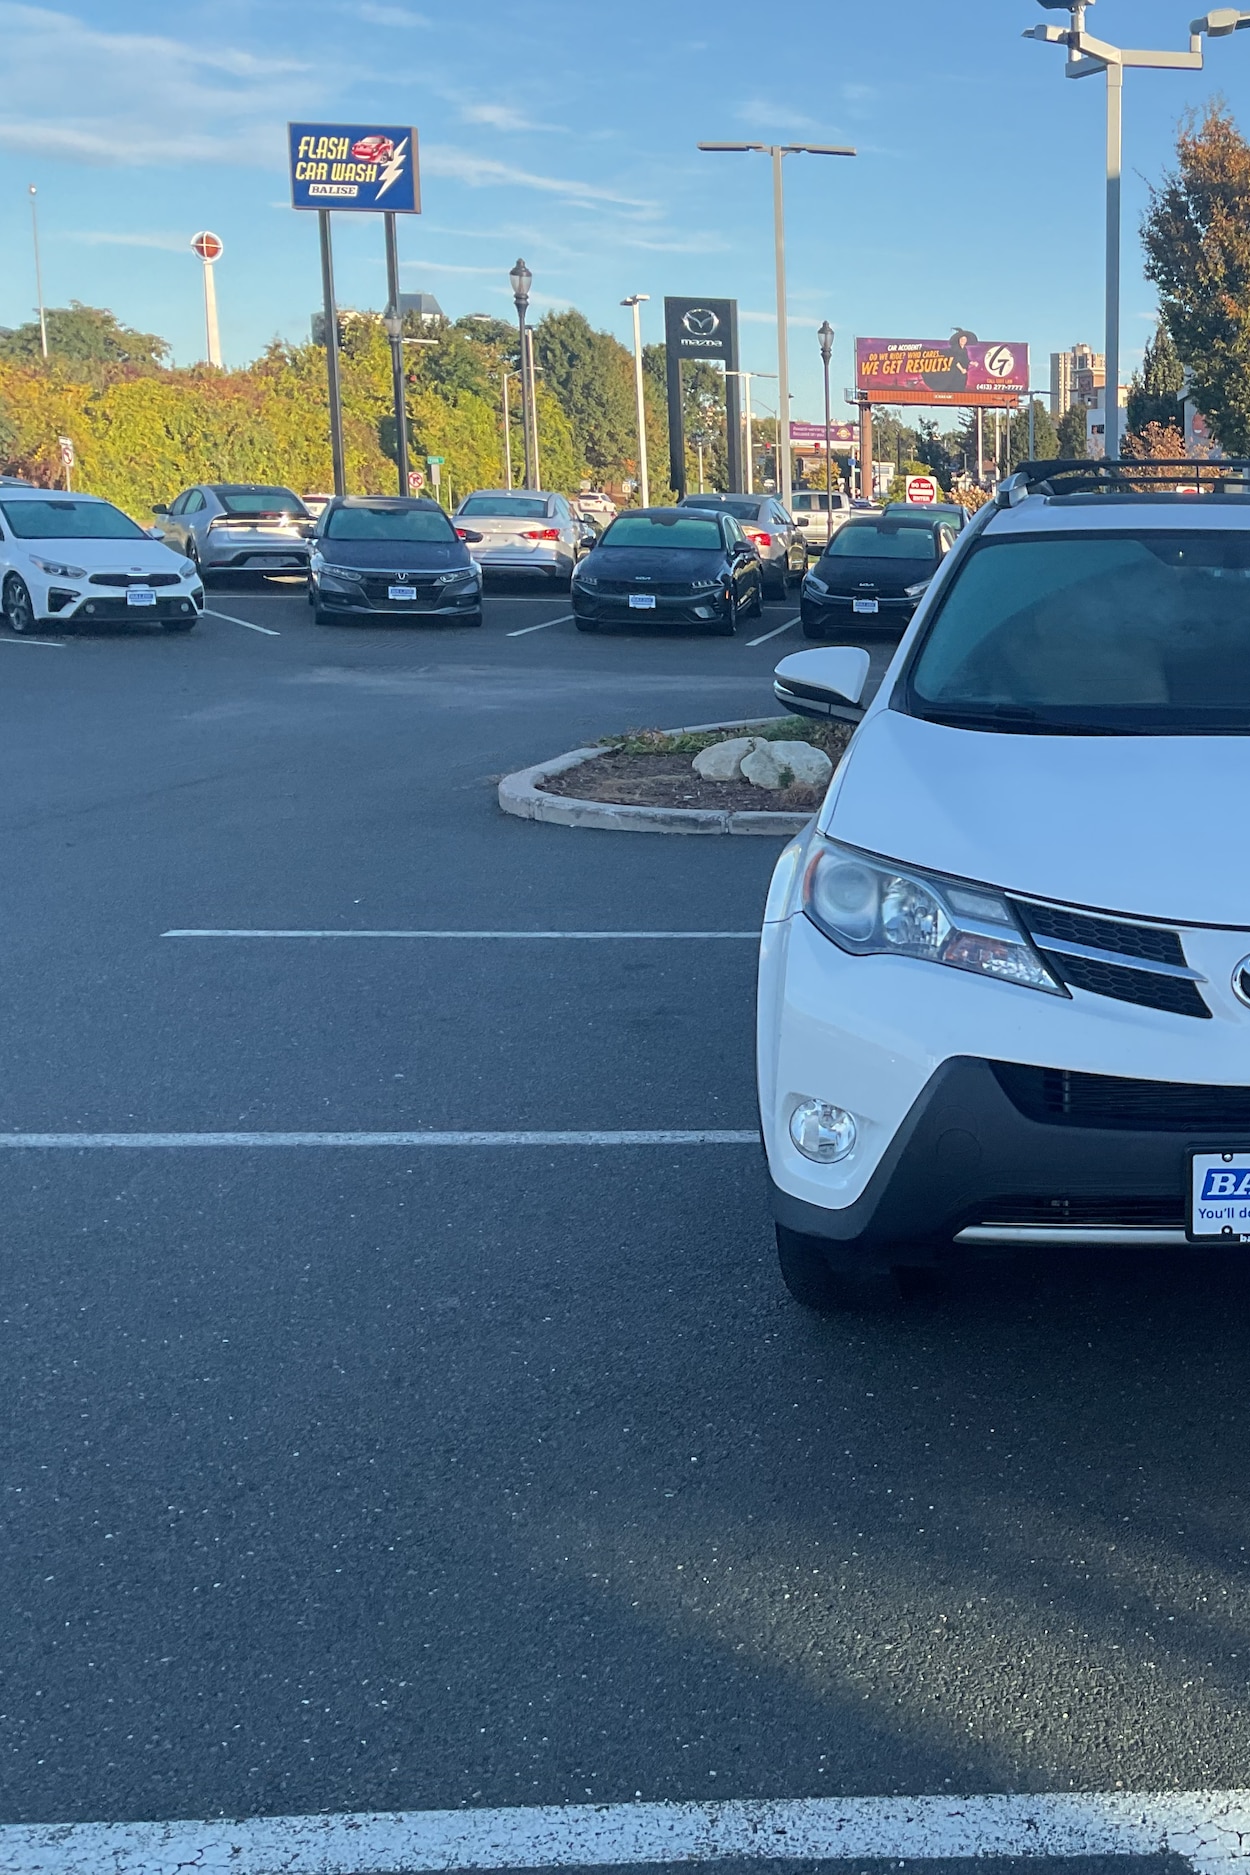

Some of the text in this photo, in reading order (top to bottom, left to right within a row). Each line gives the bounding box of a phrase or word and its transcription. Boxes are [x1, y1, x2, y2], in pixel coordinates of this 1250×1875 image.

[298, 136, 349, 160] FLASH
[295, 161, 378, 182] CAR WASH
[311, 185, 356, 195] BALISE
[887, 343, 923, 352] CAR ACCIDENT?
[879, 353, 889, 361] WE
[907, 351, 922, 359] WHO
[861, 356, 954, 376] WE GET RESULTS!
[1198, 1207, 1235, 1219] You'll
